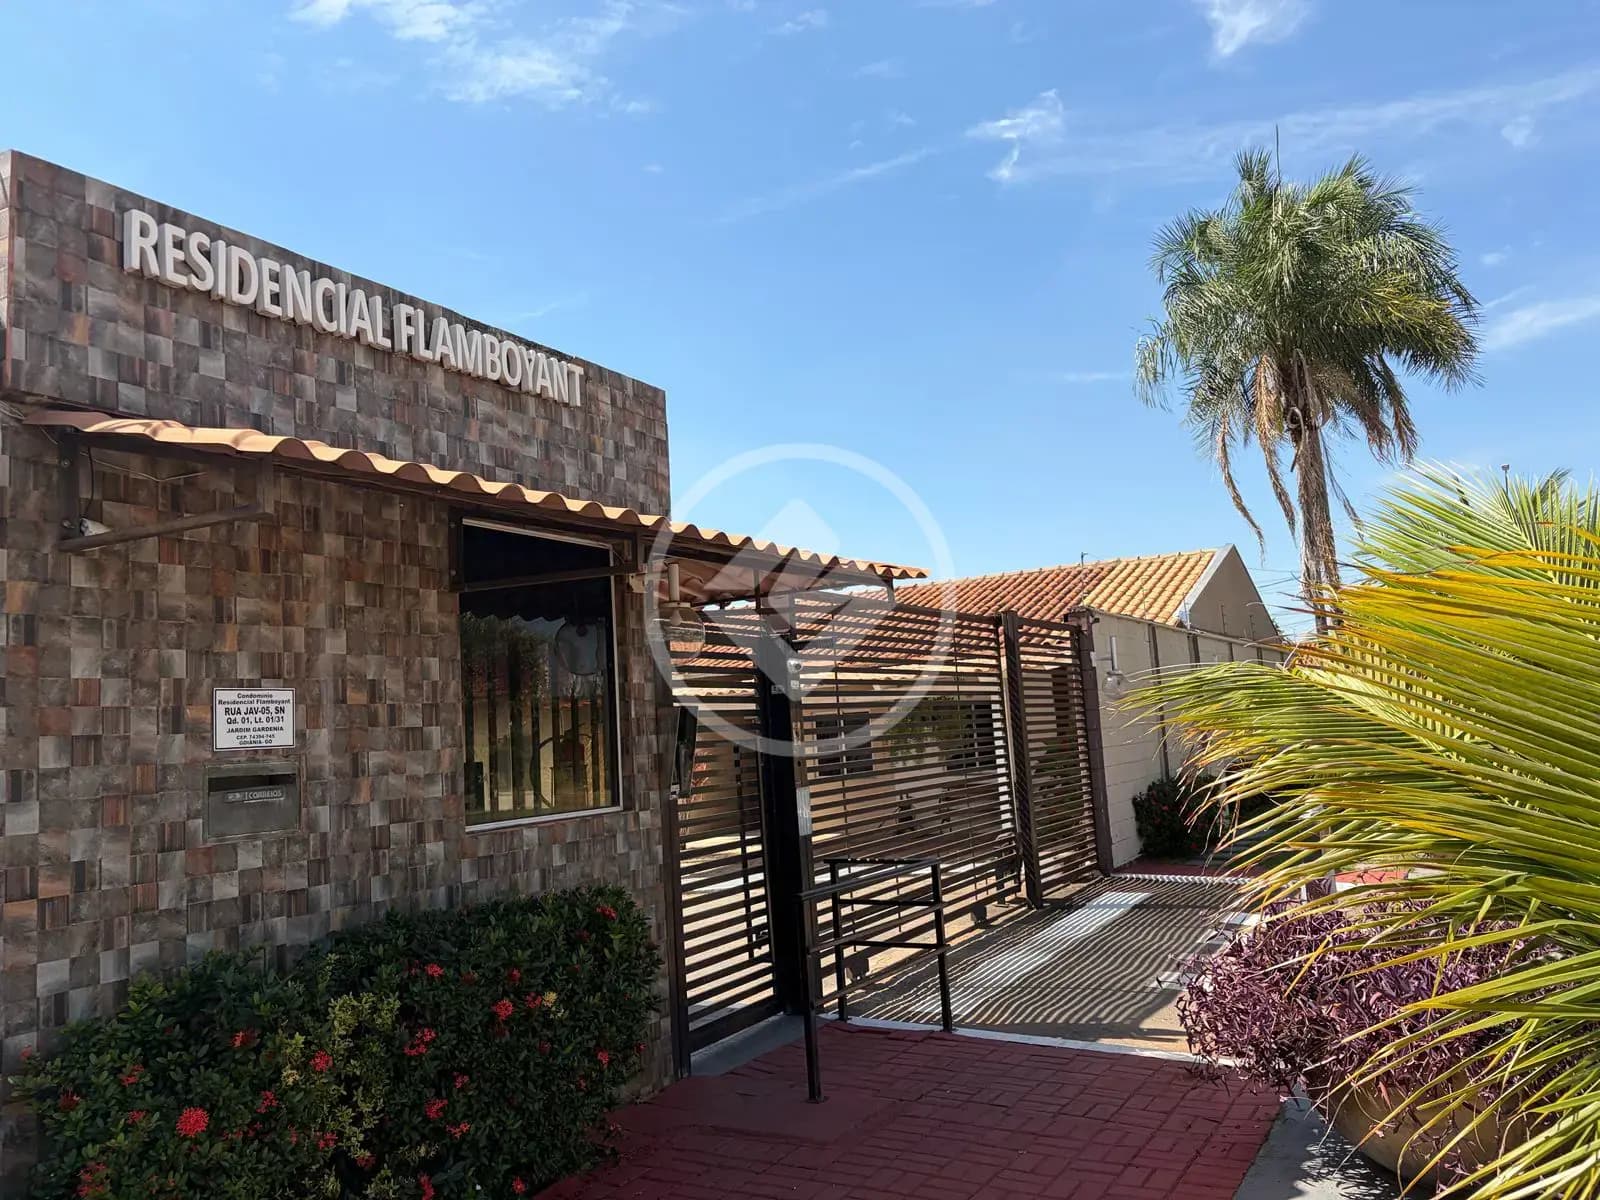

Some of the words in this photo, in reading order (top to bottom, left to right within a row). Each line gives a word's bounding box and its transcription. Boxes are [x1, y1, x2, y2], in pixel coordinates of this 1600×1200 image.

[123, 208, 392, 350] RESIDENCIAL
[392, 302, 584, 407] FLAMBOYANT
[224, 707, 242, 716] RUA
[243, 706, 273, 716] JAV-05,
[274, 706, 285, 715] SN
[226, 717, 239, 725] Qd.
